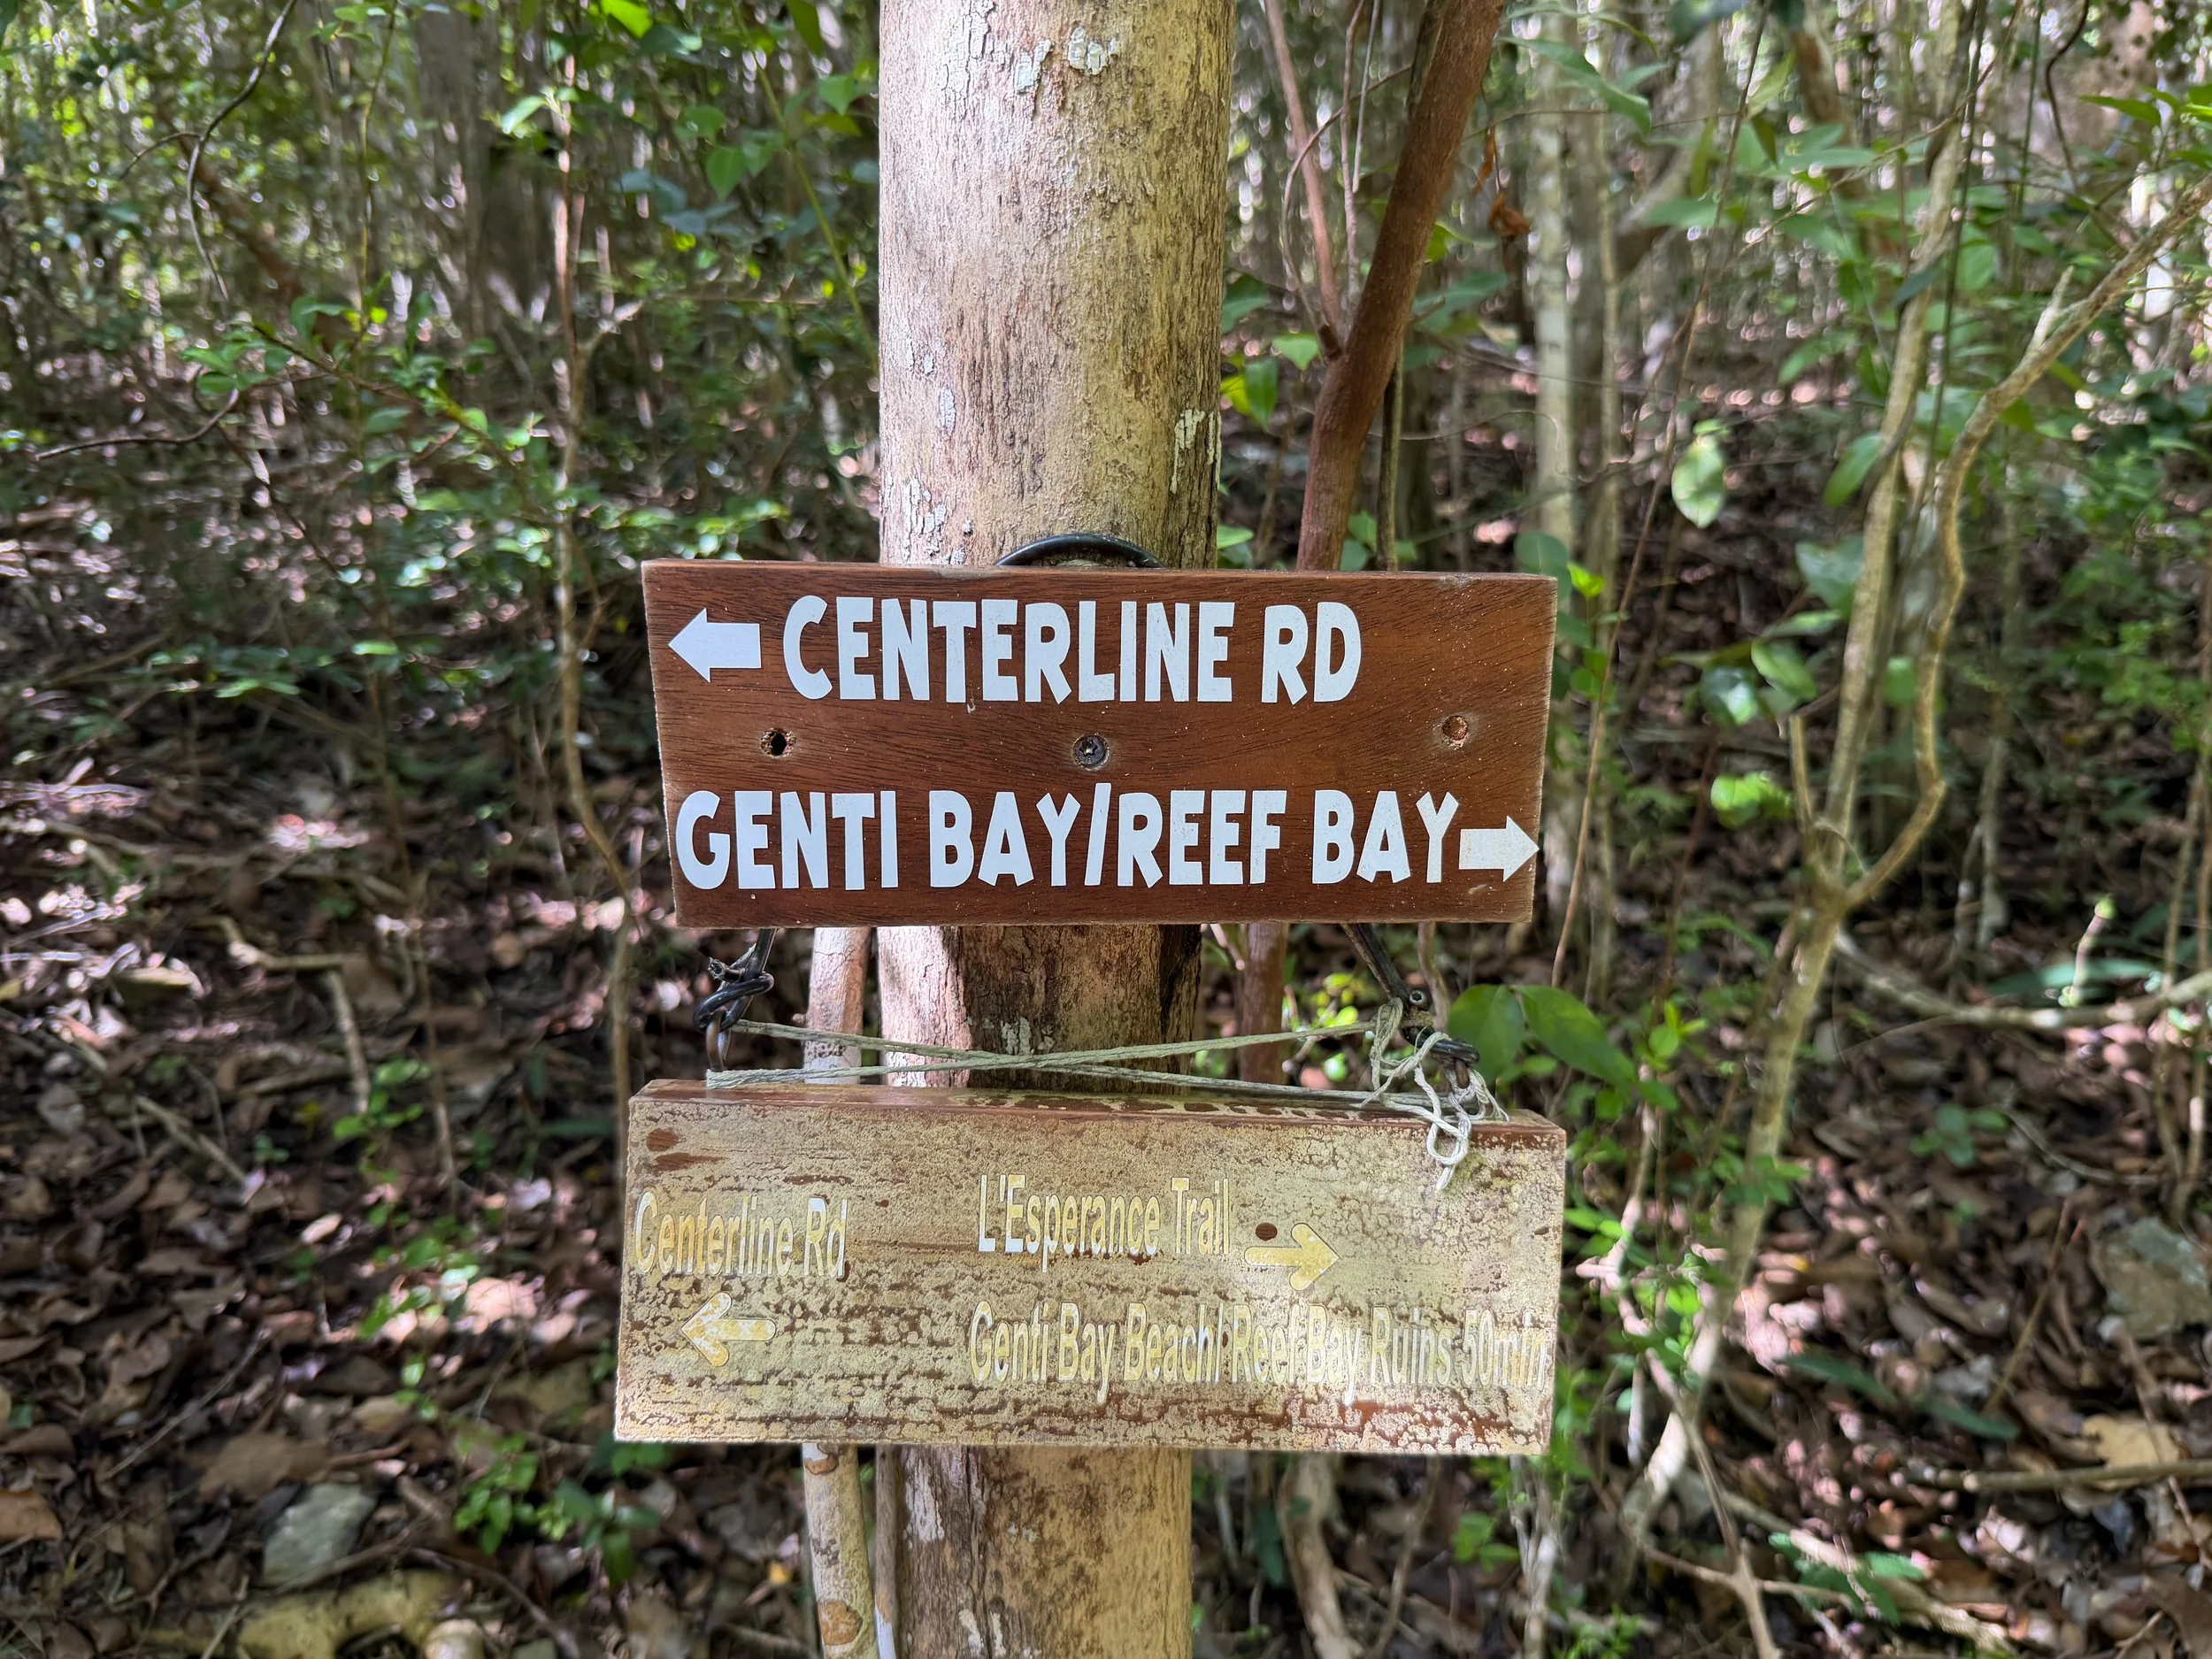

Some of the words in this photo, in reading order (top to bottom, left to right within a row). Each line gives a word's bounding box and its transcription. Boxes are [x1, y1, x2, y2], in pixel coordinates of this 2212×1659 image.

[784, 595, 1236, 704] CENTERLINE
[1261, 601, 1363, 706] RD
[676, 790, 898, 890] GENTI
[929, 782, 1287, 888] BAY/REEF
[1311, 788, 1459, 885] BAY
[634, 1191, 794, 1277] Centerline
[804, 1197, 849, 1279] Rd
[978, 1174, 1161, 1272] L'Esperance
[1171, 1177, 1230, 1255] Trail
[971, 1301, 1049, 1382] Genti
[1058, 1302, 1117, 1403] Bay
[1307, 1304, 1363, 1407] Bay
[1372, 1305, 1452, 1386] Ruins
